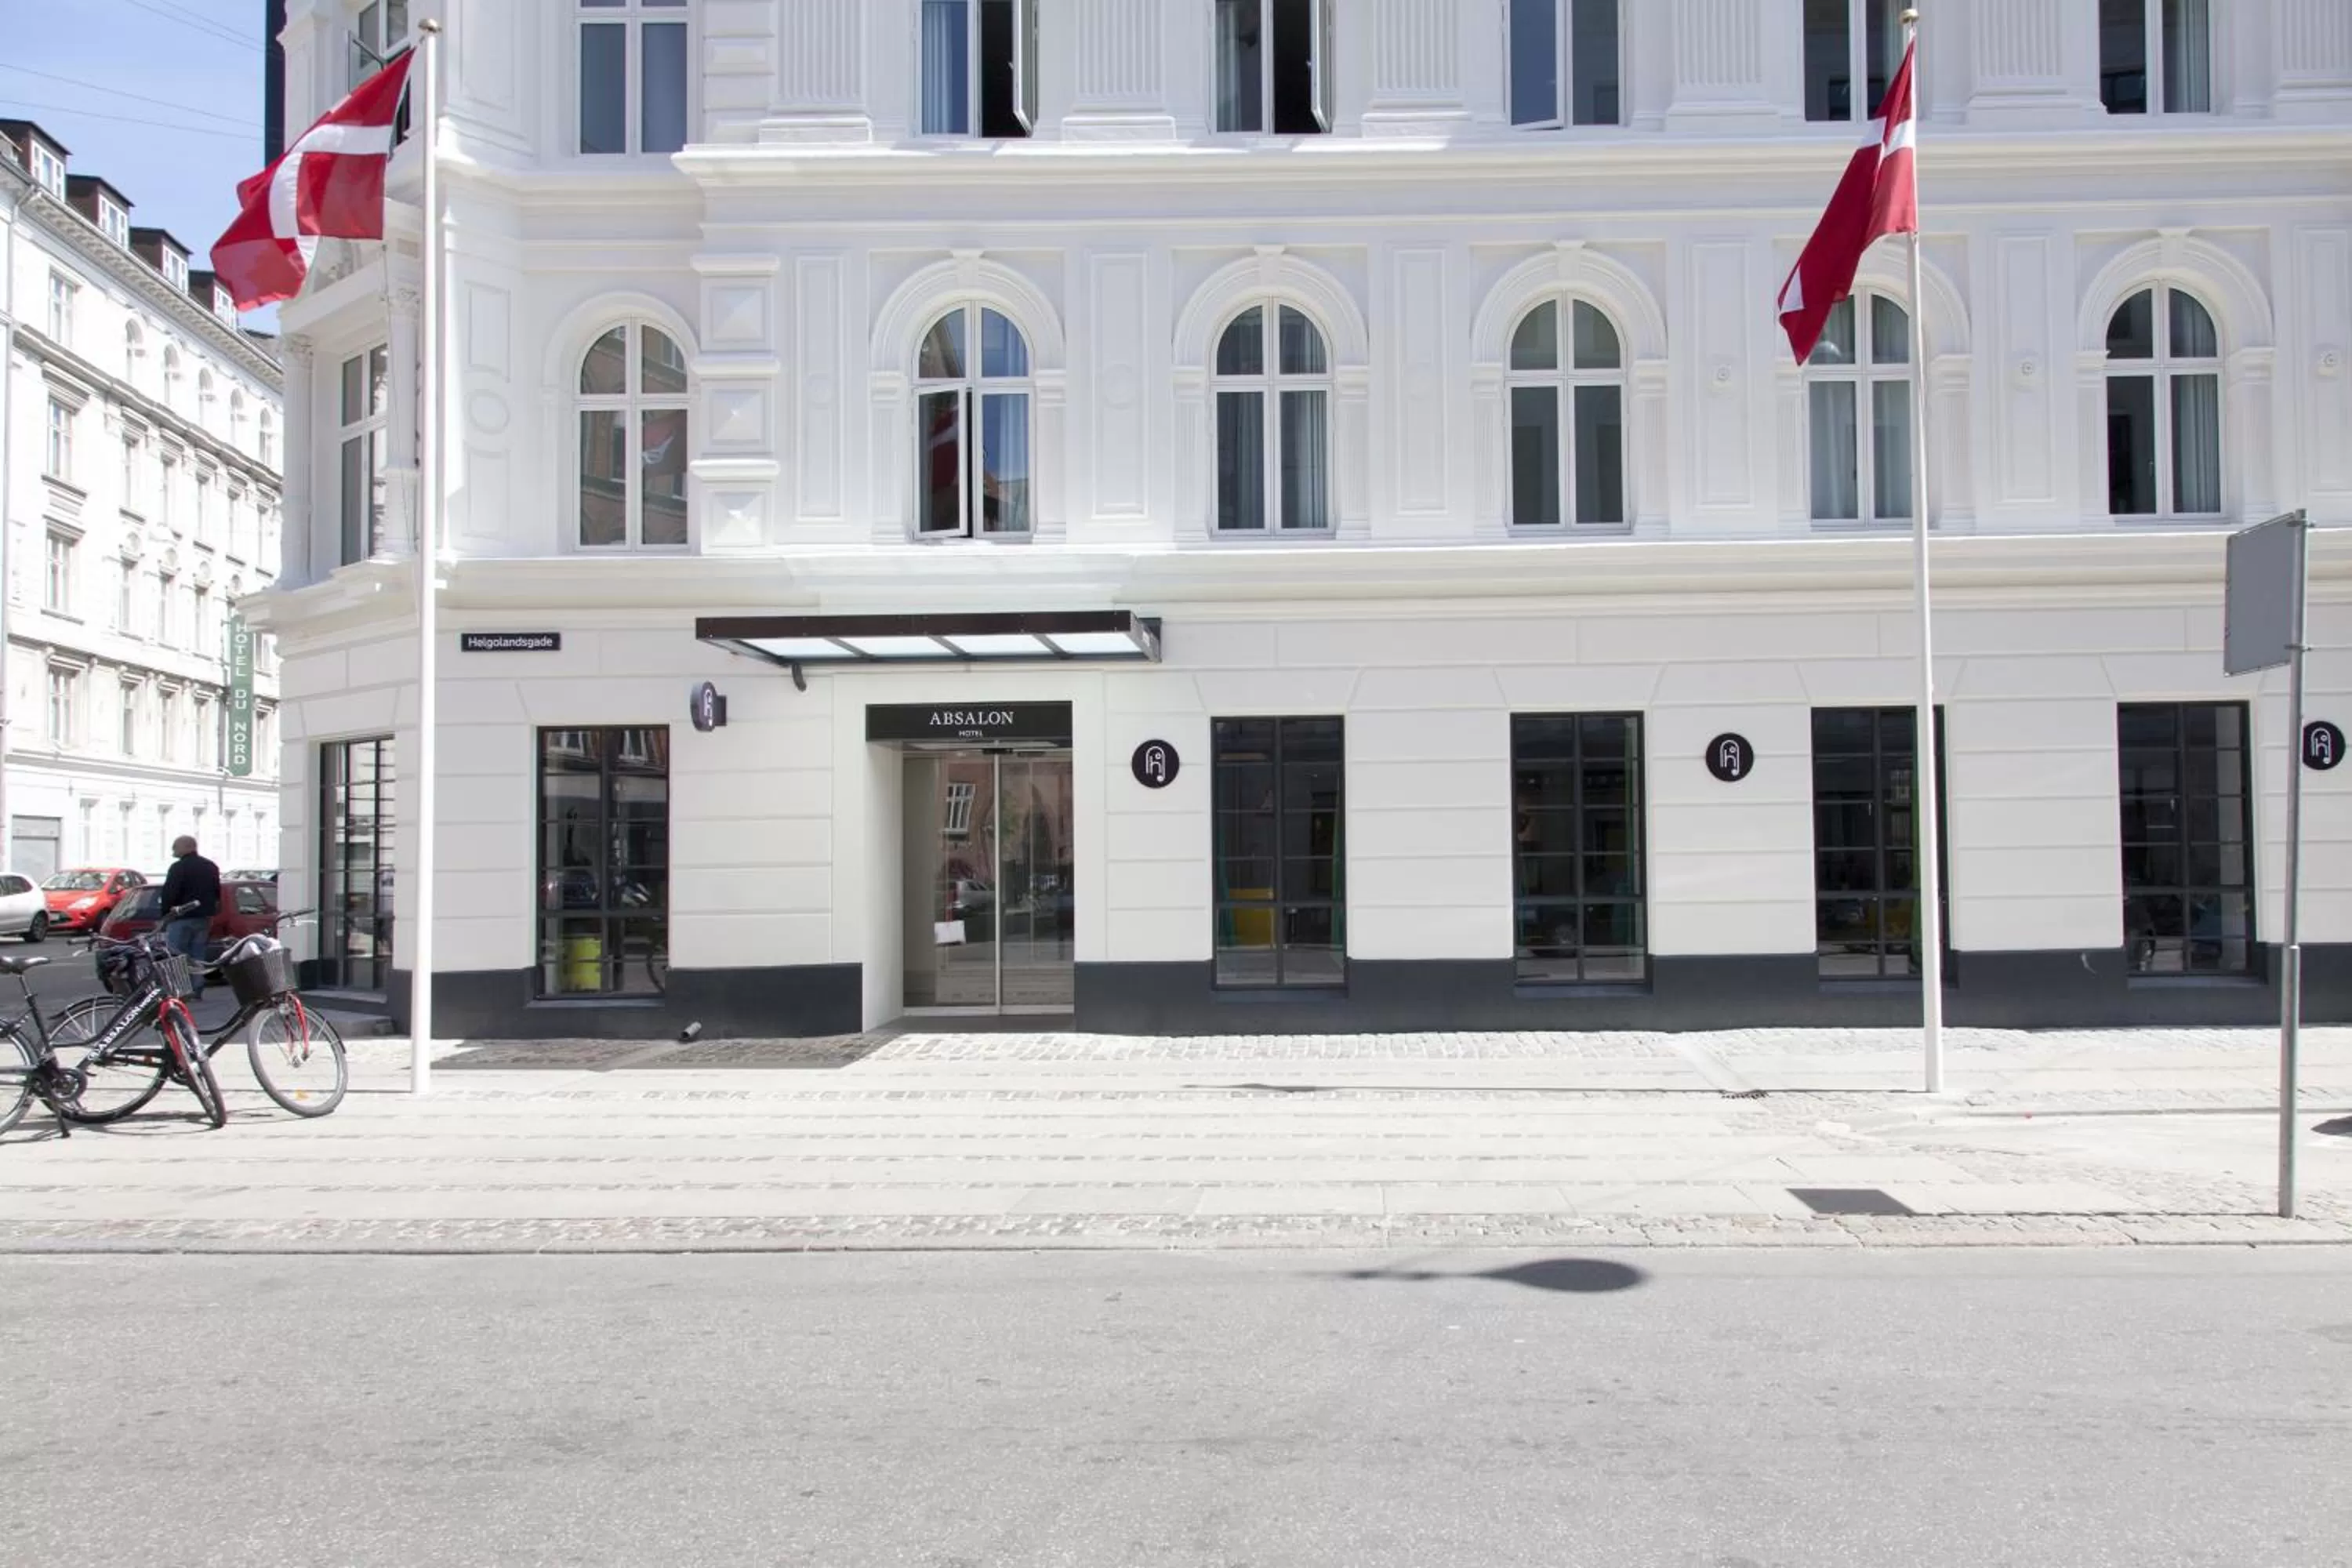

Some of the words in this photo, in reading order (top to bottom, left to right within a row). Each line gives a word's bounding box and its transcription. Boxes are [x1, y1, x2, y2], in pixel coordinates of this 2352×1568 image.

[236, 622, 248, 677] HOTEL
[468, 635, 554, 649] Helgolandsgade
[235, 689, 247, 710] DU
[929, 711, 1014, 725] ABSALON
[234, 722, 247, 764] NORD
[96, 1004, 141, 1051] ABSALON
